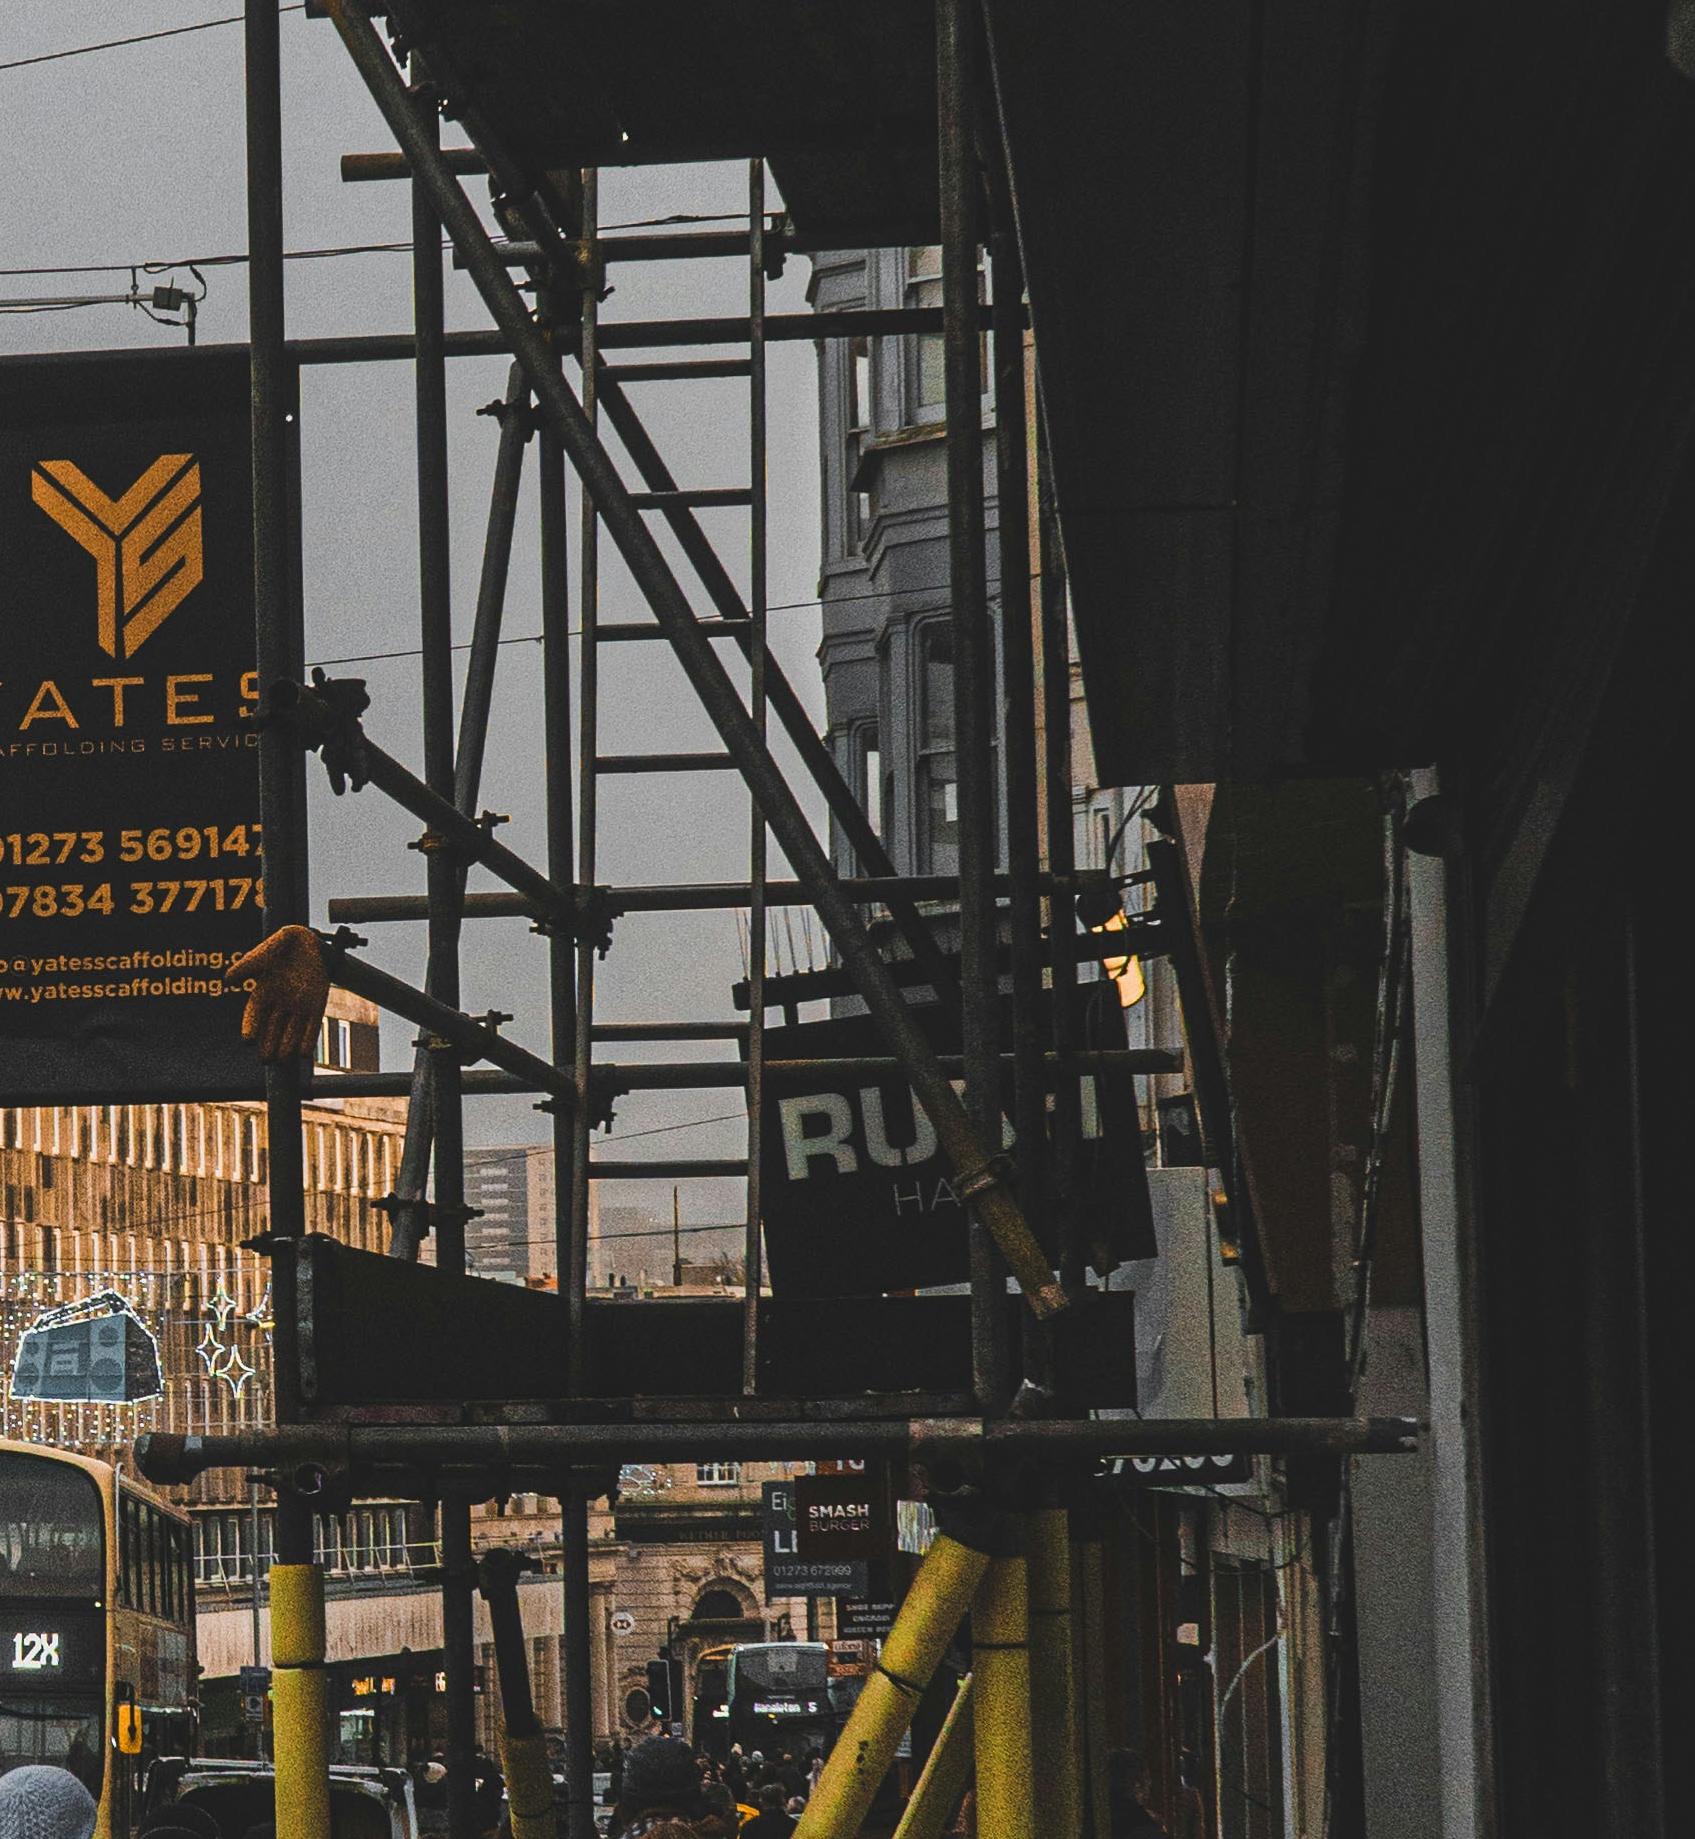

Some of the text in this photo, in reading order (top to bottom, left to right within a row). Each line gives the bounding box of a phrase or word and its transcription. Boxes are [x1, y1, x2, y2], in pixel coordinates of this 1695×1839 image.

[162, 733, 261, 751] SERVIC
[893, 1177, 963, 1217] HA
[808, 1503, 869, 1519] SMASH
[809, 1519, 870, 1532] BURGER
[12, 1633, 59, 1669] 12X
